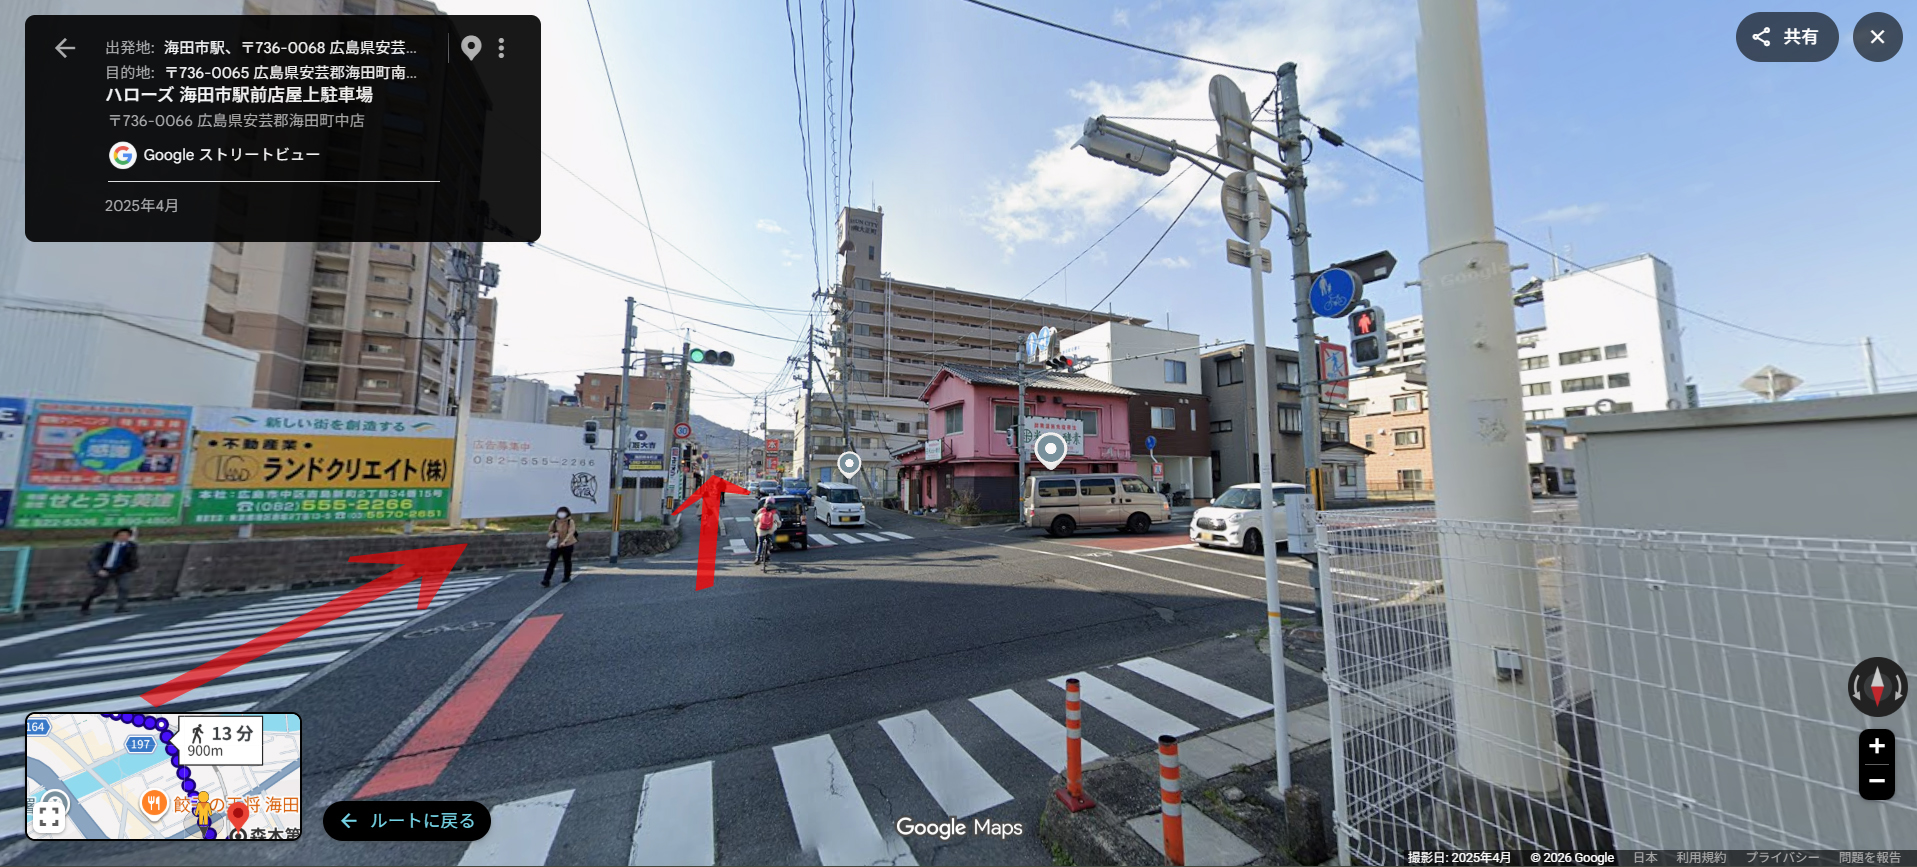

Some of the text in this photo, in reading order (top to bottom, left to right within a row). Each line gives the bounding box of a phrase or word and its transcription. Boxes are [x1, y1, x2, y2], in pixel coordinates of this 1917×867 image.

[265, 416, 405, 432] 新しい街を創造する
[678, 427, 687, 435] 30
[223, 437, 298, 451] 不動産業
[1033, 429, 1081, 446] 米酵素
[473, 440, 530, 452] 広告募集中
[263, 457, 447, 482] ランドクリエイト(株)
